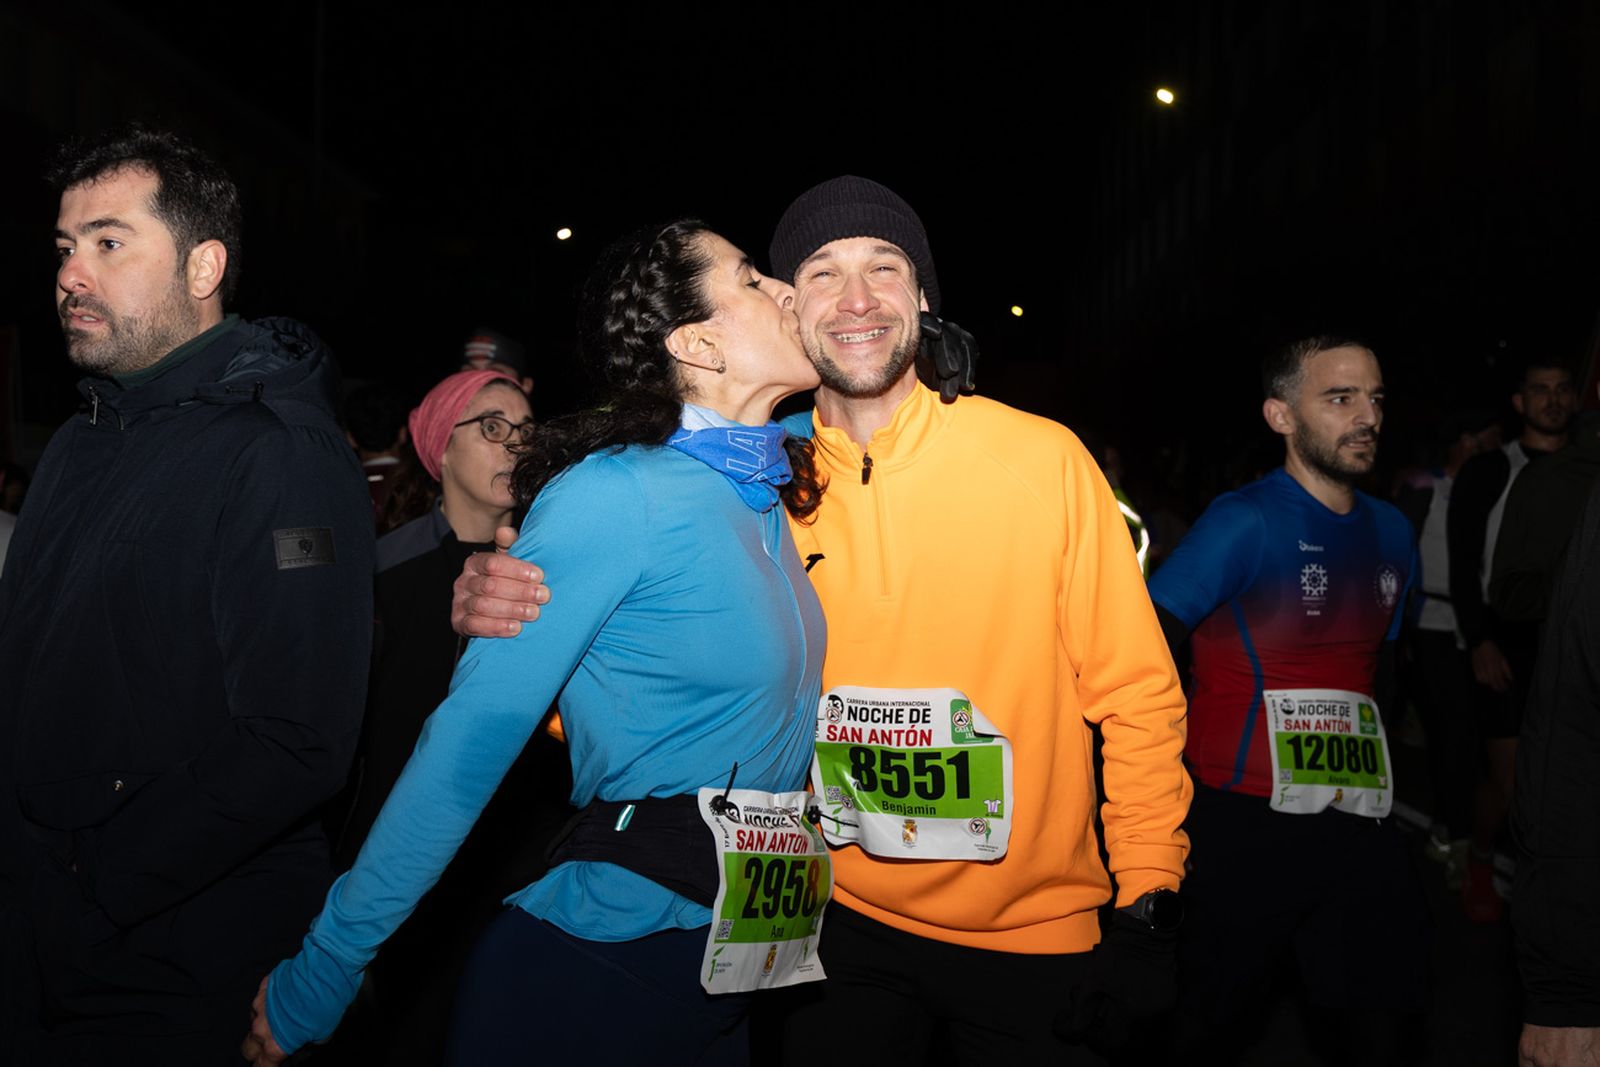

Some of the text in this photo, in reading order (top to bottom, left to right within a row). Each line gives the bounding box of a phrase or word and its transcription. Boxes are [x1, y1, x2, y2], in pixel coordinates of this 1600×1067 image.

[846, 698, 868, 706] CARRERA
[1298, 704, 1351, 717] NOCHE DE
[847, 706, 931, 724] NOCHE DE
[1284, 719, 1312, 732] SAN
[1314, 717, 1352, 733] ANTÓN
[826, 724, 863, 744] SAN
[868, 724, 932, 747] ANTÓN
[1286, 735, 1378, 775] 12080
[849, 746, 970, 800] 8551
[882, 800, 937, 816] Benjamin
[736, 829, 767, 852] SAN
[741, 856, 820, 920] 2958
[770, 924, 785, 938] Ana
